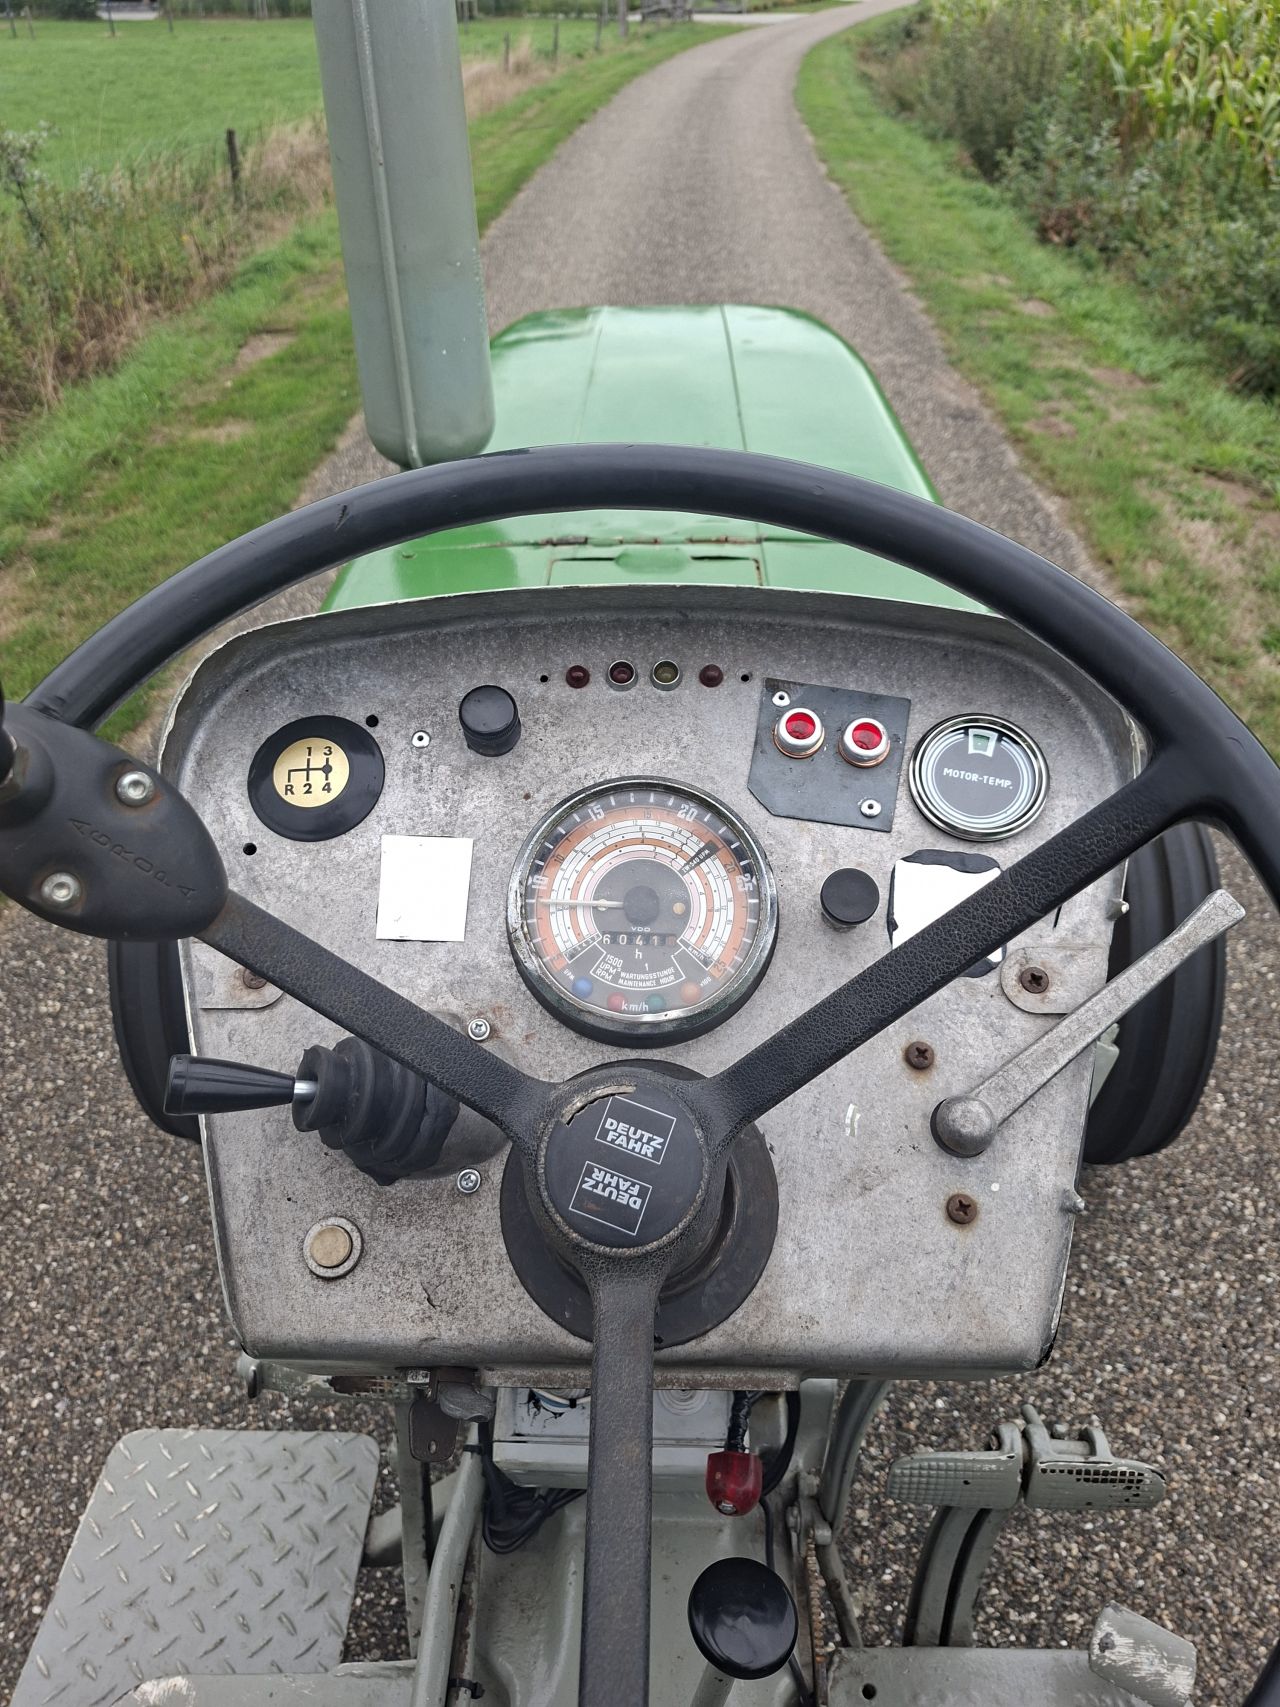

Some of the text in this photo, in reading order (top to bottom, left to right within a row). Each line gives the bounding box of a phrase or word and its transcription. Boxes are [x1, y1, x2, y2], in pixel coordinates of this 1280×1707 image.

[306, 746, 332, 756] 1 3
[943, 767, 1014, 790] MOTOR-TEMP.
[284, 783, 332, 795] R 2 4
[588, 805, 606, 821] 15
[677, 803, 698, 822] 20
[554, 855, 565, 864] 10
[724, 860, 736, 874] 20
[635, 948, 642, 959] h
[605, 954, 623, 967] 1500
[596, 968, 613, 981] RPM
[600, 962, 616, 974] UPM
[620, 966, 676, 980] WARTUNGSSTUNDE
[618, 975, 675, 987] MAINTENANCE HOUR
[620, 1000, 649, 1012] km/h
[604, 1117, 665, 1149] DEUTZ
[606, 1130, 654, 1158] FAHR
[591, 1167, 640, 1196] FAHR
[582, 1177, 643, 1210] DEUTZ
